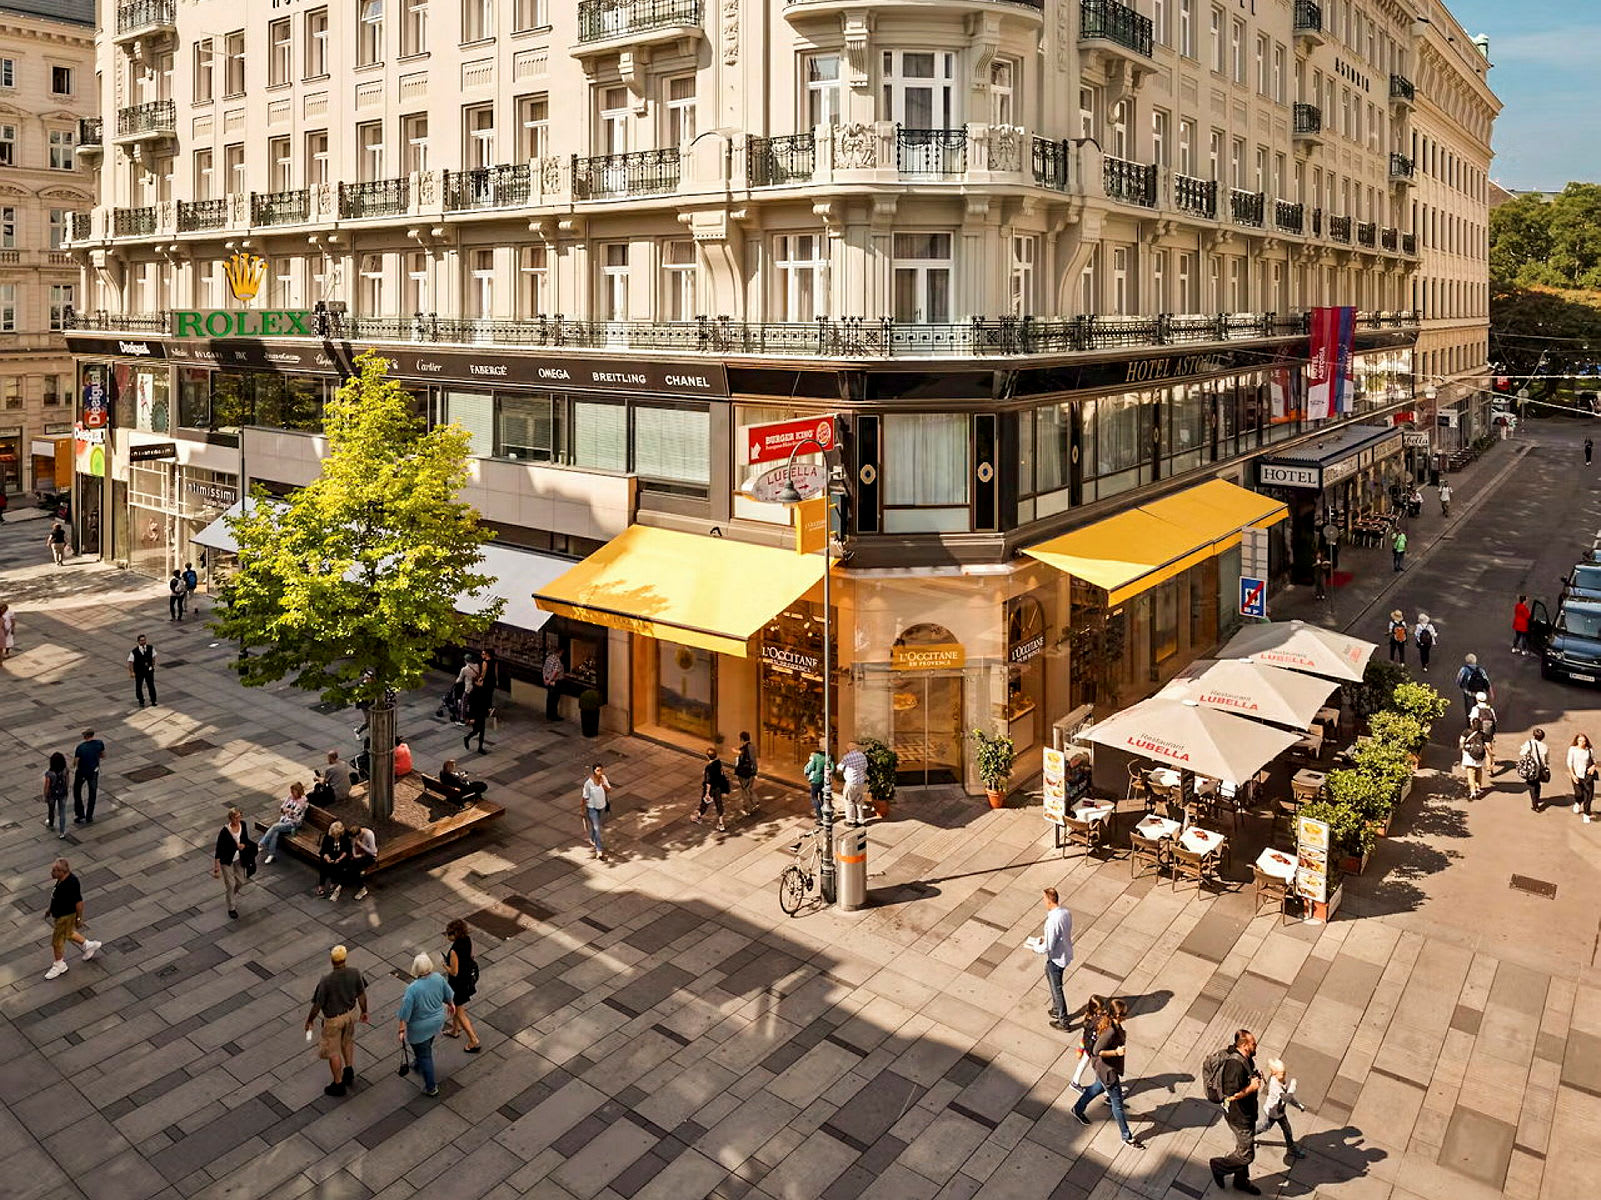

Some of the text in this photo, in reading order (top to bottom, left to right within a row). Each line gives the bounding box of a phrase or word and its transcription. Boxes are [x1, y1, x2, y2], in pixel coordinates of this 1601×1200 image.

[1335, 57, 1369, 93] ASTORIA
[175, 311, 312, 338] ROLEX
[416, 359, 442, 372] Cartier
[538, 367, 571, 380] OMEGA
[1125, 358, 1171, 382] HOTEL
[592, 371, 647, 385] BREITLING
[664, 374, 711, 388] CHANEL
[765, 432, 795, 445] BURGER
[795, 429, 815, 440] KING
[1263, 468, 1318, 485] HOTEL
[762, 646, 818, 667] L'OCCITANE
[900, 651, 958, 662] L'OCCITANE
[1260, 653, 1316, 667] LUBELLA
[1199, 694, 1259, 711] LUBELLA
[1126, 736, 1190, 762] LUBELLA
[1140, 733, 1185, 751] Restaurant
